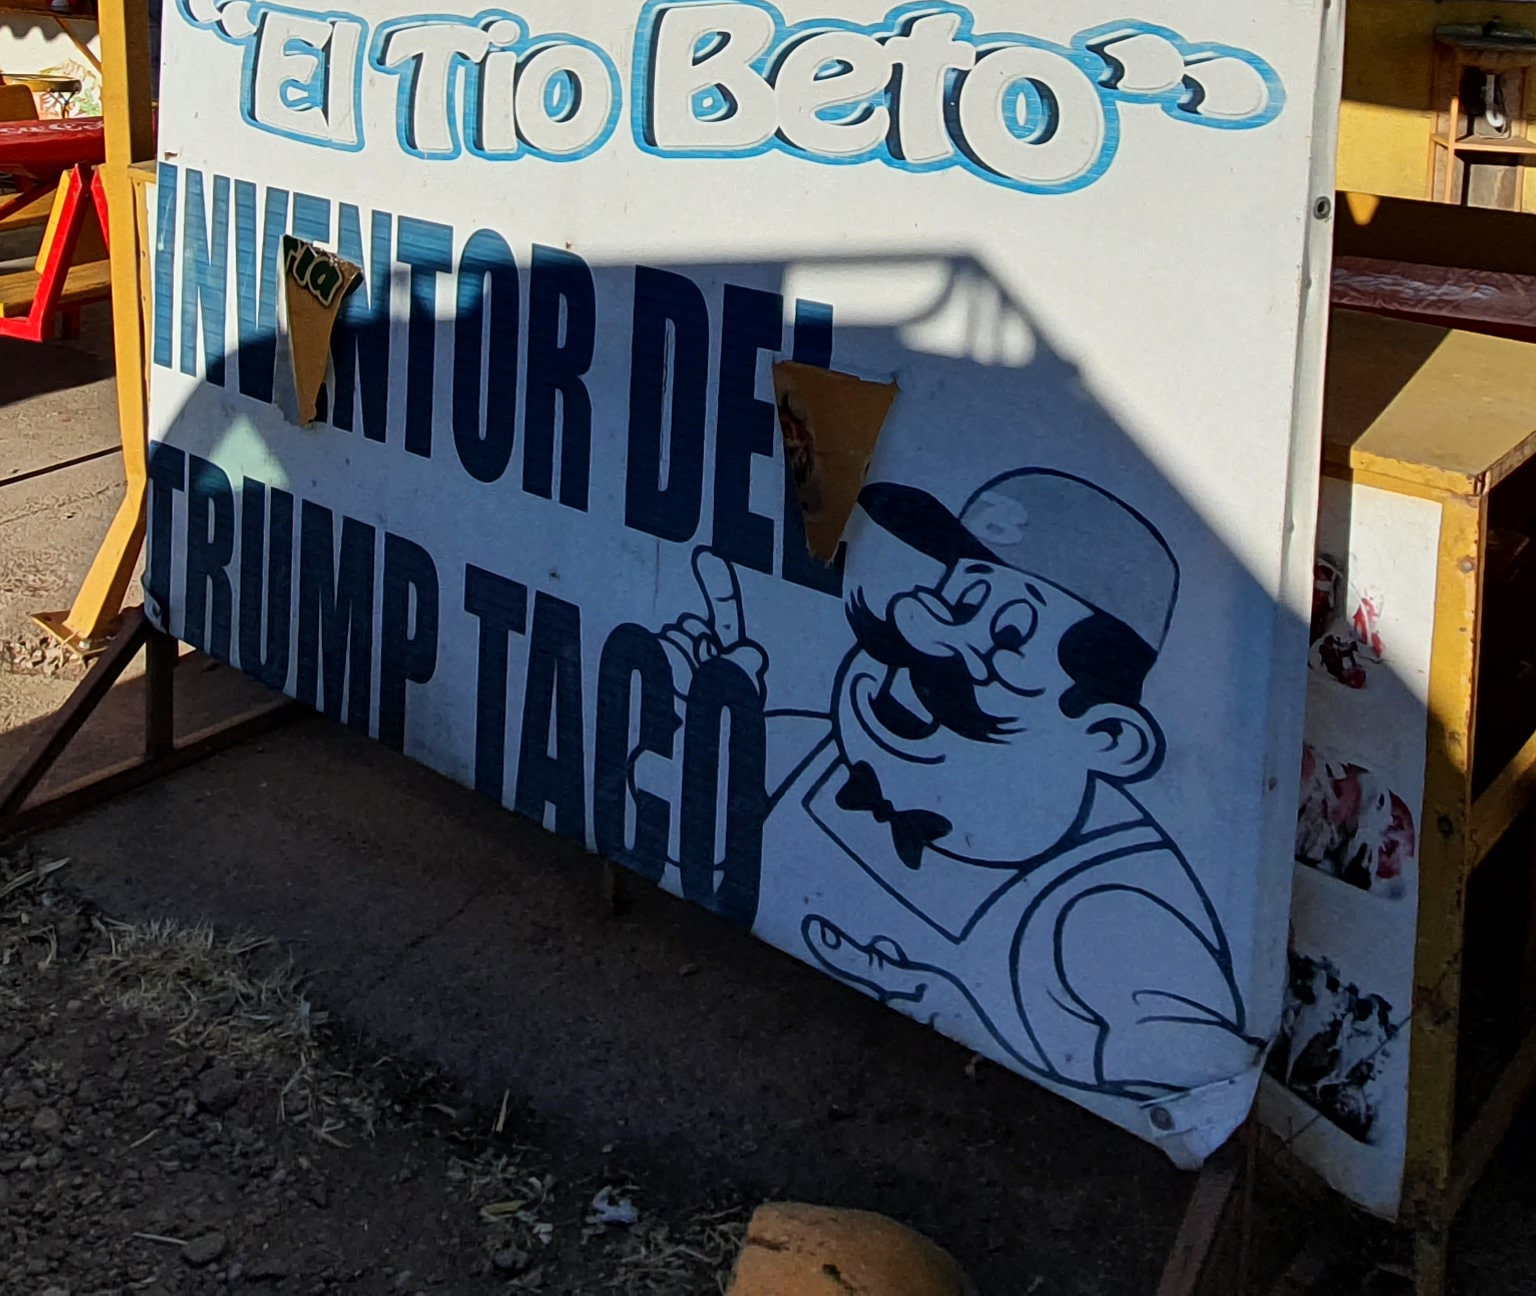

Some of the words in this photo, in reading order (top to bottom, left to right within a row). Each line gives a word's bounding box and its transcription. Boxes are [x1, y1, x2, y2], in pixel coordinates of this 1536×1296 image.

[153, 161, 600, 514] INVNTOR
[145, 439, 440, 754] TRUMP
[463, 562, 768, 933] TACO
